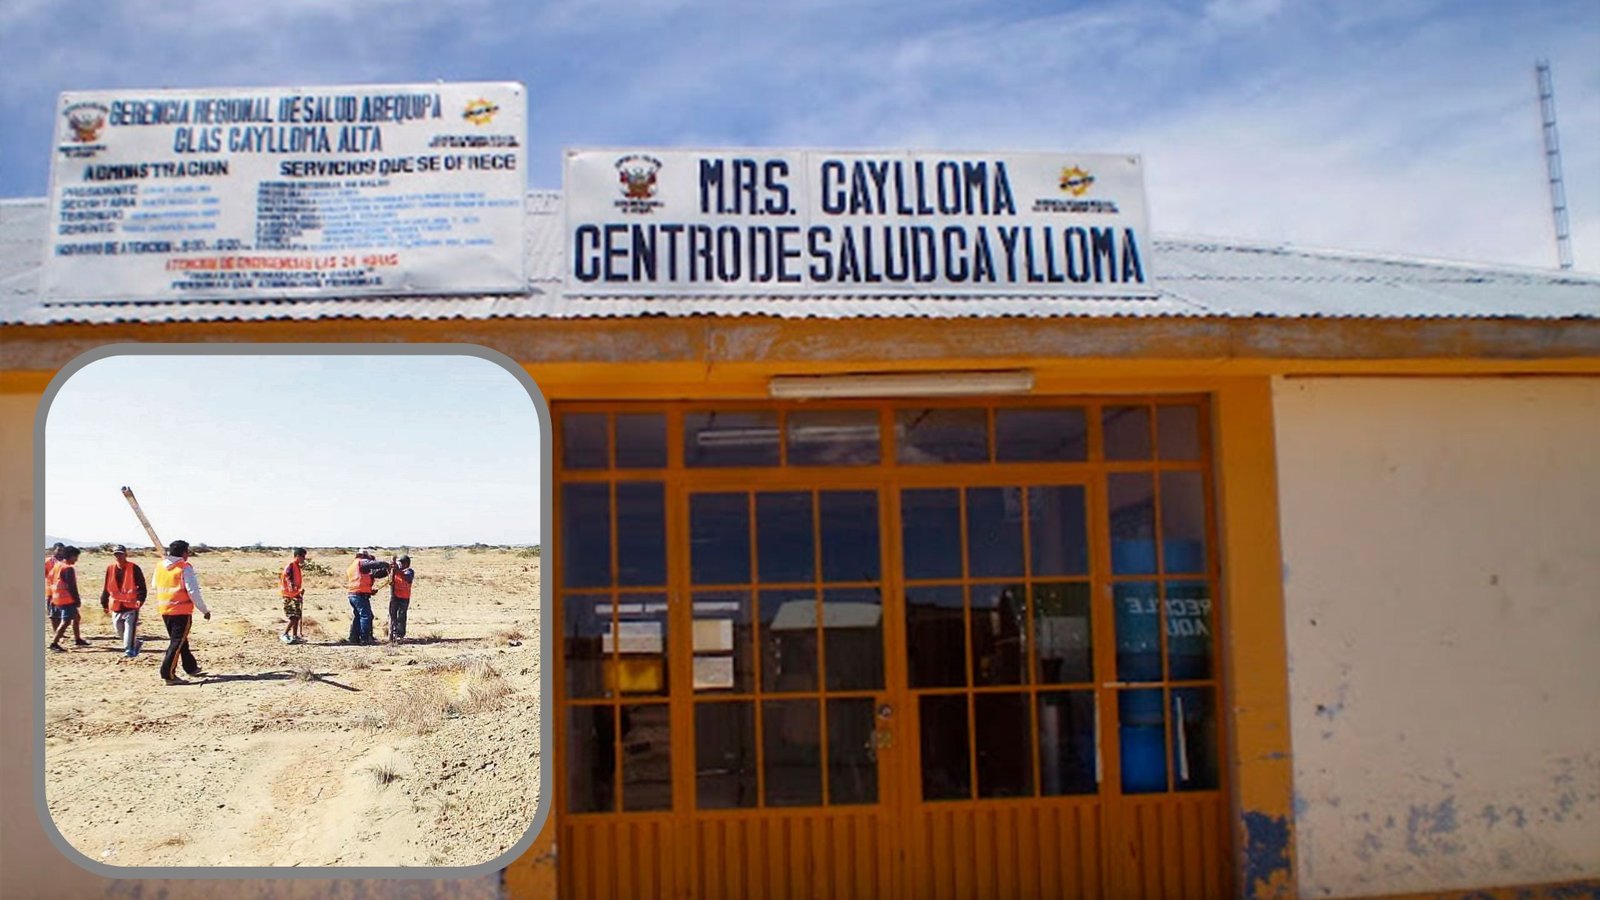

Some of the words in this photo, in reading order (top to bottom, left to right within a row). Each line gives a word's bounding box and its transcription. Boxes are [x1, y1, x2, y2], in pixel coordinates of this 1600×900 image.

[110, 99, 188, 125] GERENCIA
[193, 97, 274, 124] REGIONAL
[303, 96, 358, 122] SALUD
[360, 93, 442, 124] AREQUIPA
[174, 126, 222, 153] CLAS
[228, 125, 331, 153] CAYLLOMA
[337, 125, 383, 153] ALTA
[279, 159, 376, 177] SERVICIOS
[378, 156, 414, 176] QUE
[416, 155, 441, 172] SE
[444, 153, 516, 171] OFRECE
[699, 158, 797, 216] M.R.S.
[820, 158, 1017, 217] CAYLLOMA
[574, 223, 741, 284] CENTRO
[748, 223, 803, 284] DE
[806, 224, 938, 284] SALUD
[941, 224, 1146, 284] CAYLLOMA
